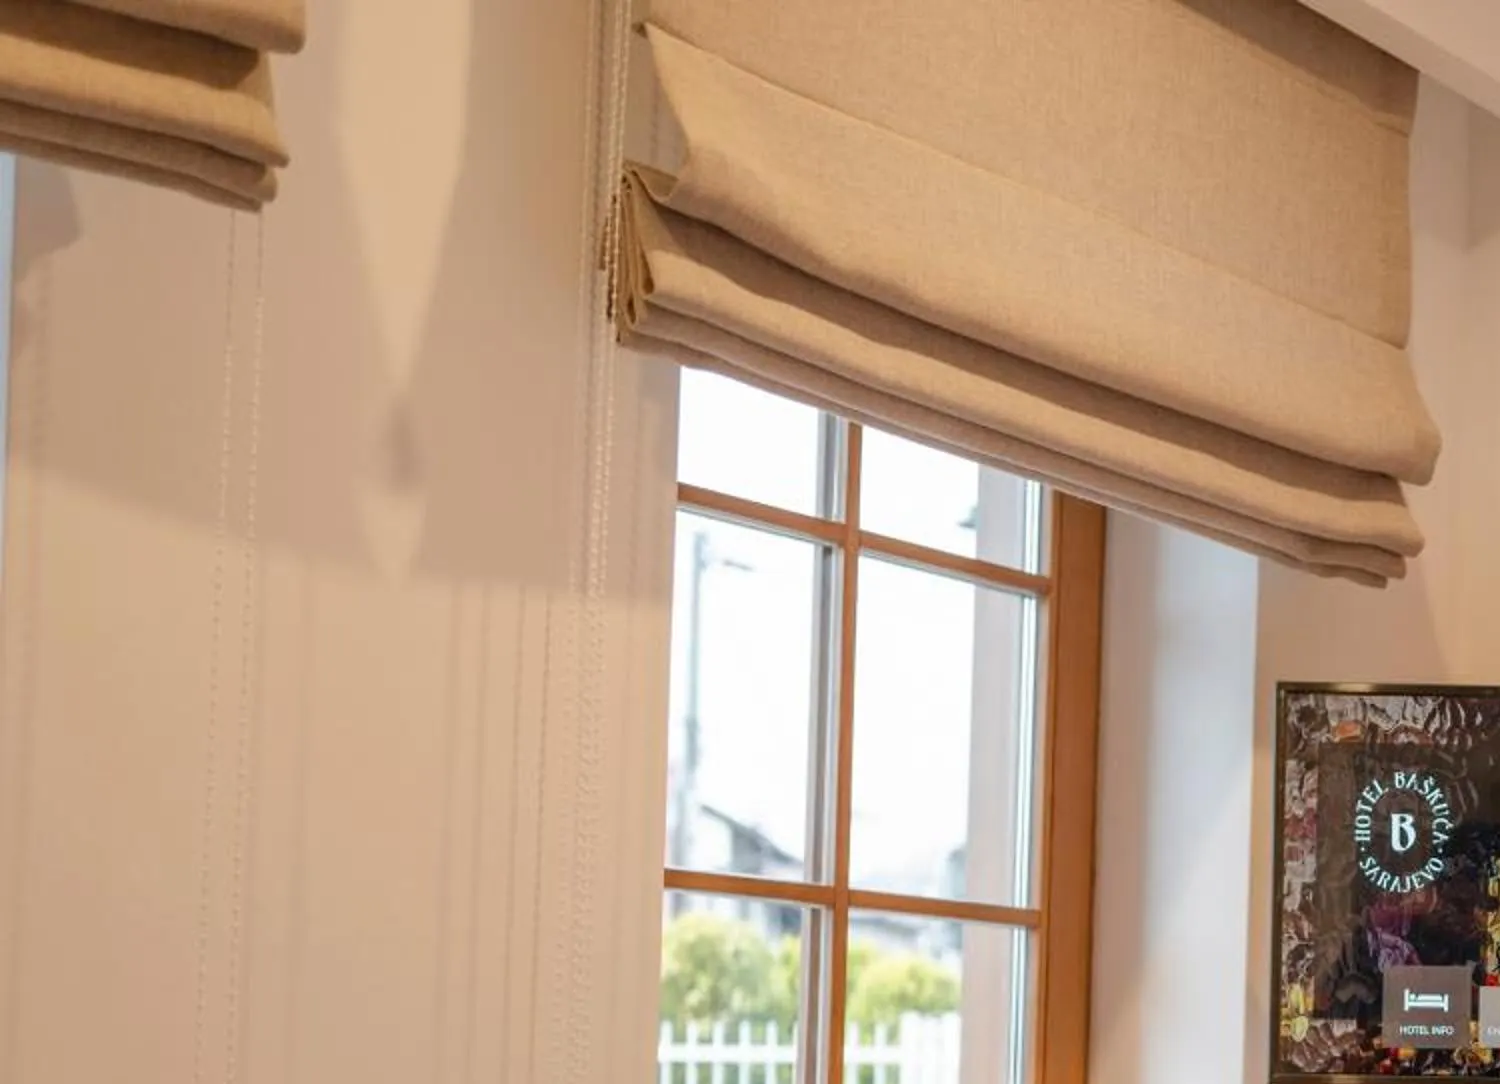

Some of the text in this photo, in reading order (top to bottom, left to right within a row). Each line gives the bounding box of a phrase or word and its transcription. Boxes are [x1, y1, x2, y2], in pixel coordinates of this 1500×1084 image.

[1354, 779, 1389, 841] HOTEL
[1390, 813, 1416, 853] B
[1359, 856, 1444, 893] SARAJEVO
[1399, 1025, 1455, 1037] HOTEL INFO
